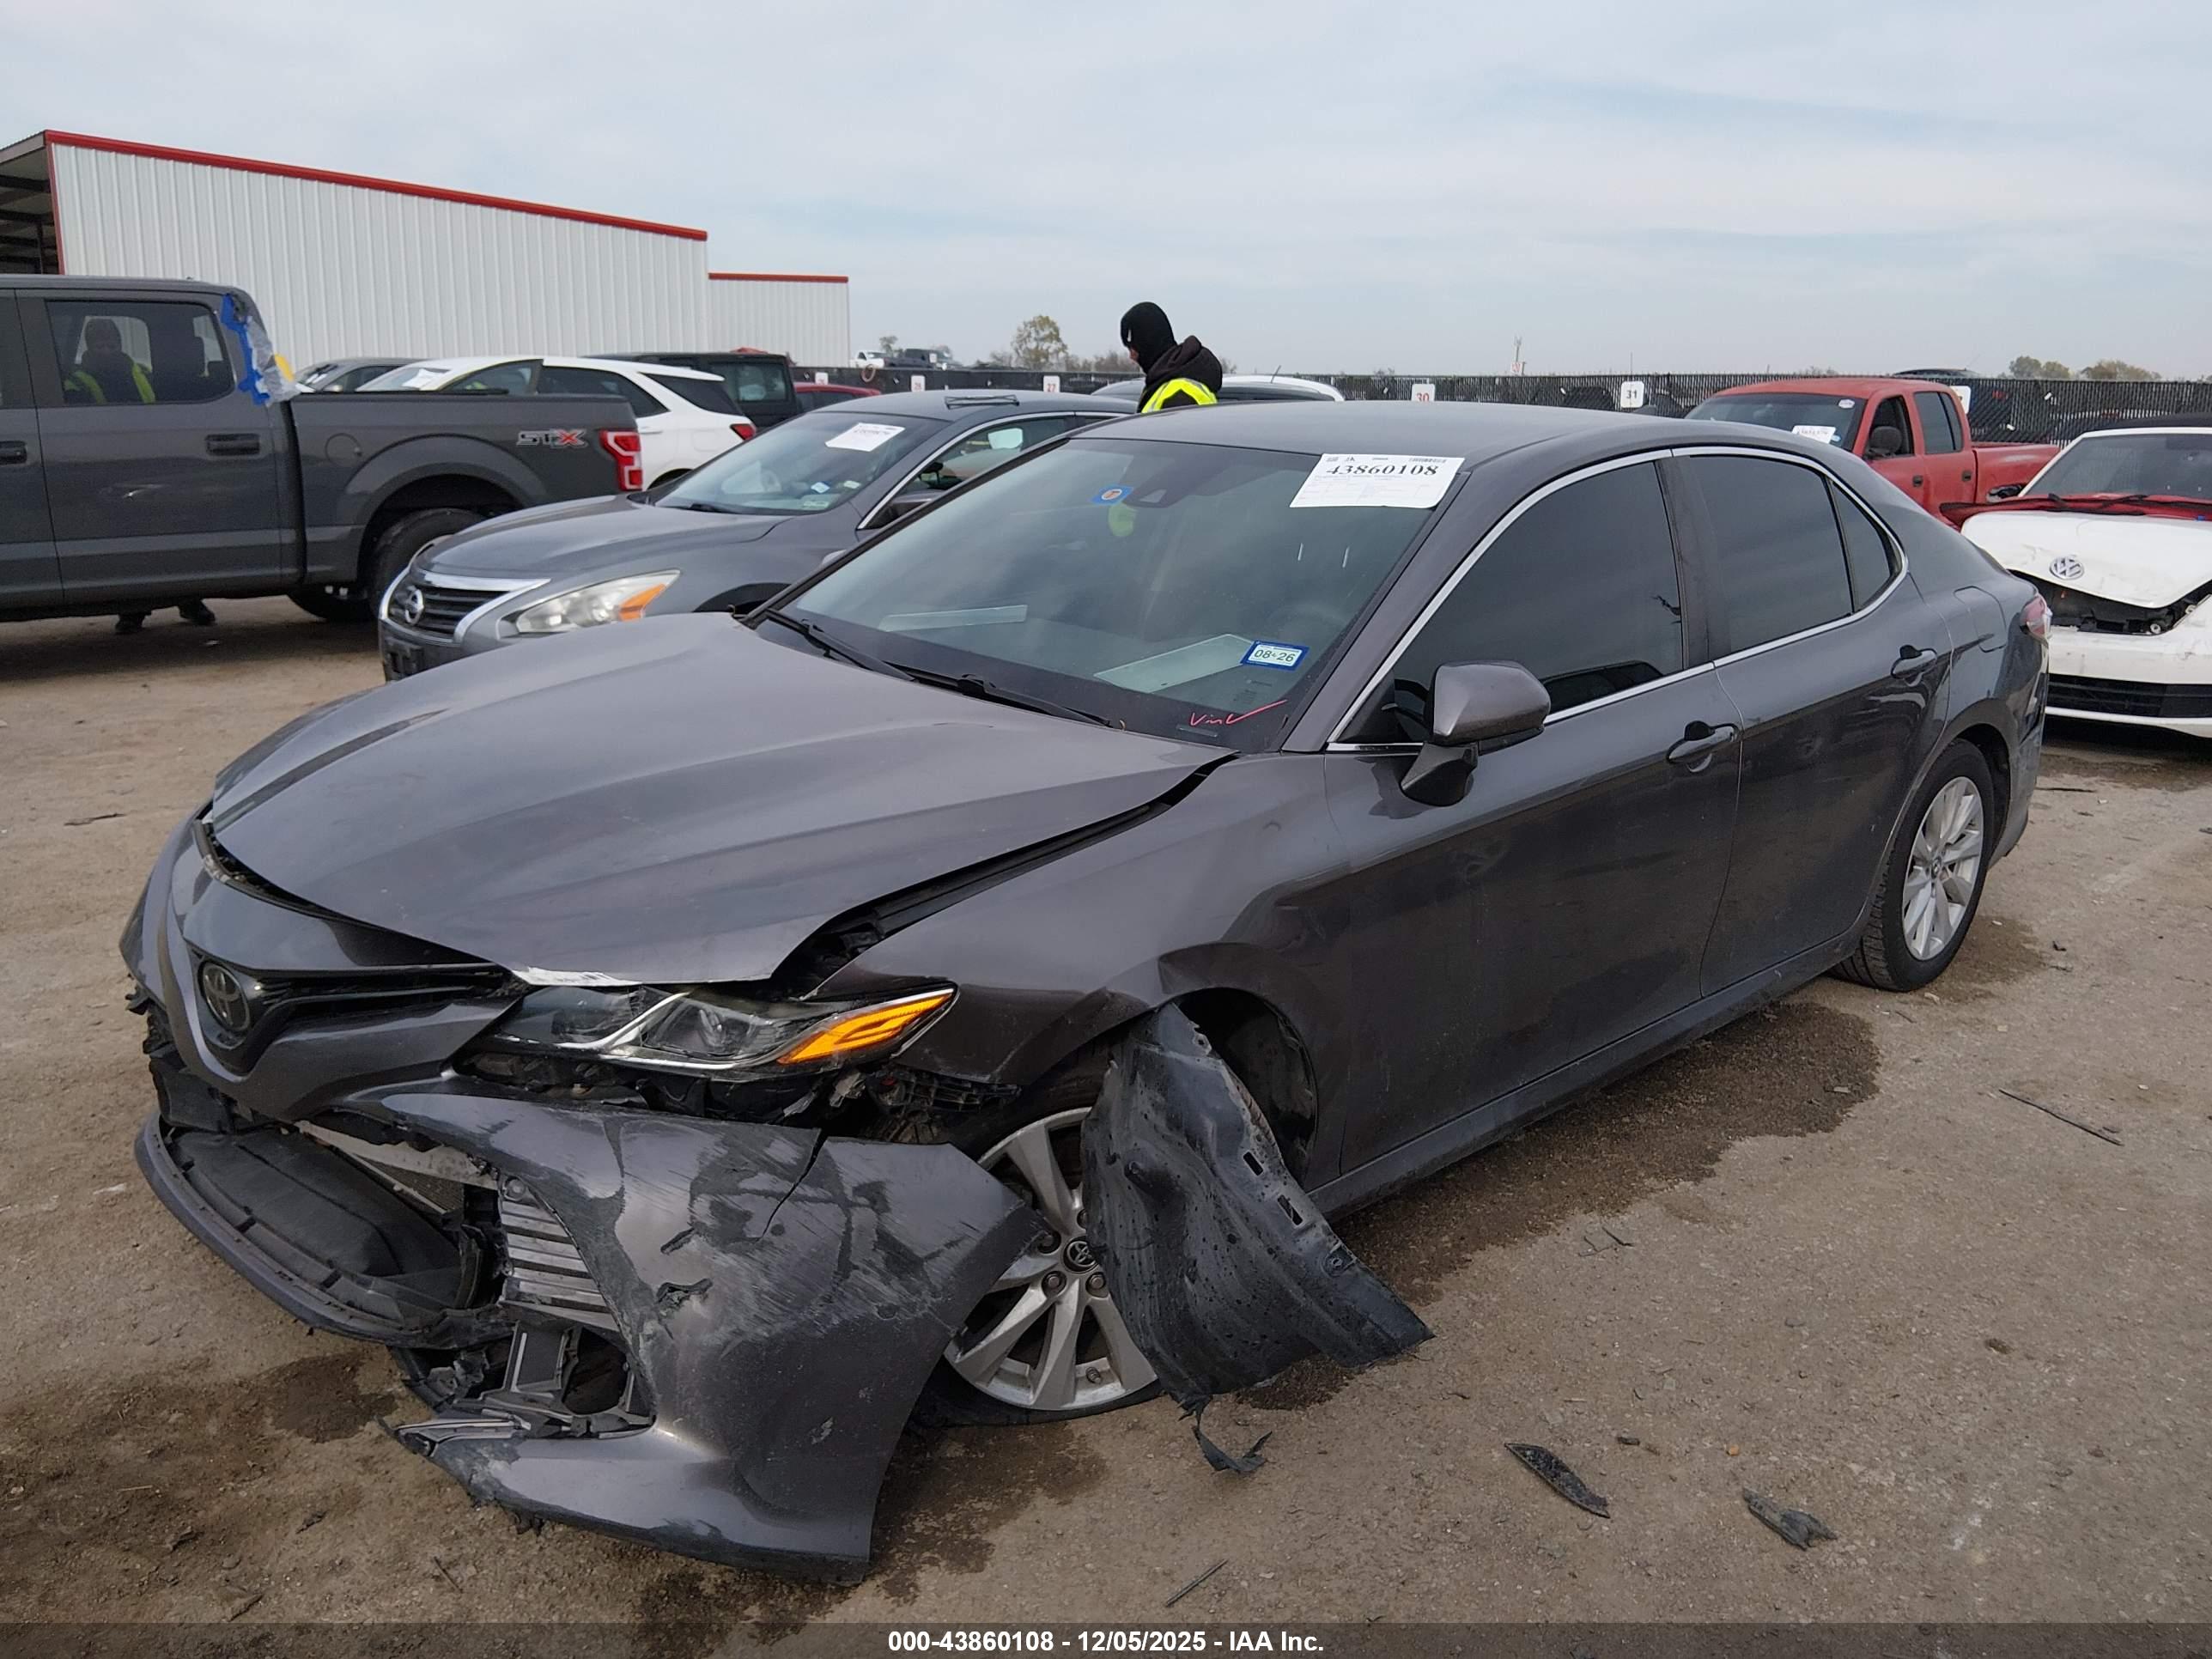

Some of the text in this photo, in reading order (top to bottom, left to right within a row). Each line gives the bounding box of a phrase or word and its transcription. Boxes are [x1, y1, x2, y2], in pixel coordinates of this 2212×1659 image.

[1626, 390, 1638, 399] 31
[517, 429, 587, 447] STX
[1326, 465, 1439, 475] 43860108
[1254, 649, 1273, 659] 08
[1277, 652, 1296, 662] 26
